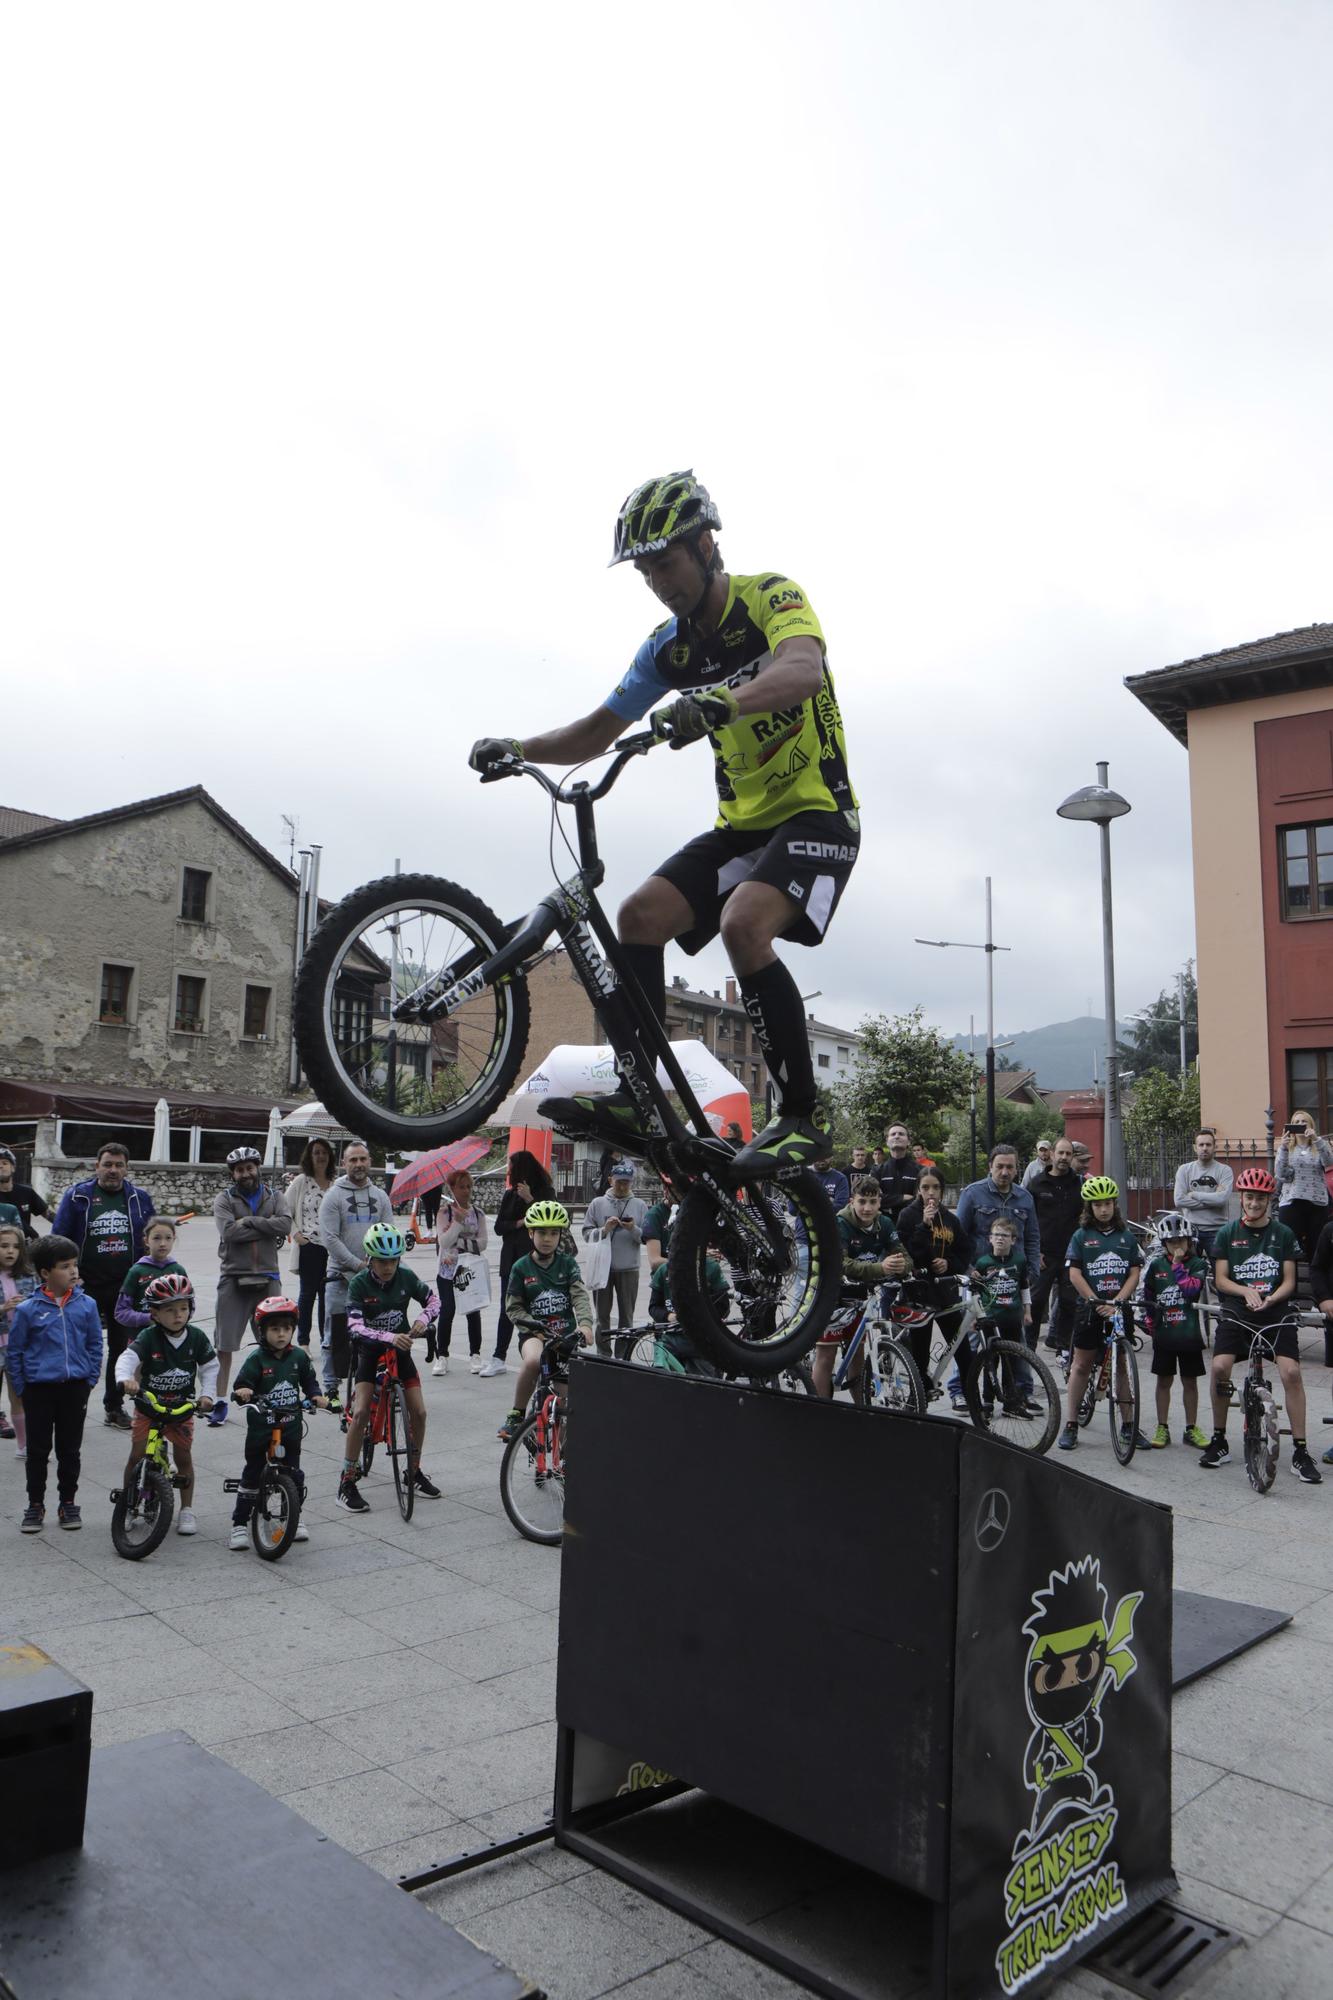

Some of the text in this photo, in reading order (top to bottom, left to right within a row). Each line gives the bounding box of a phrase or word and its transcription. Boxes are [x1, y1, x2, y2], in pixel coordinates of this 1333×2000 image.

[633, 538, 668, 556] RAW
[769, 589, 803, 610] RAW
[751, 704, 804, 743] RAW
[786, 841, 858, 862] COMAS
[580, 937, 616, 995] RAW
[443, 972, 485, 1007] RAW
[1086, 1258, 1130, 1269] senderos
[1233, 1261, 1280, 1273] senderos
[1156, 1290, 1184, 1301] sender
[1005, 1811, 1116, 1923] SENSEY
